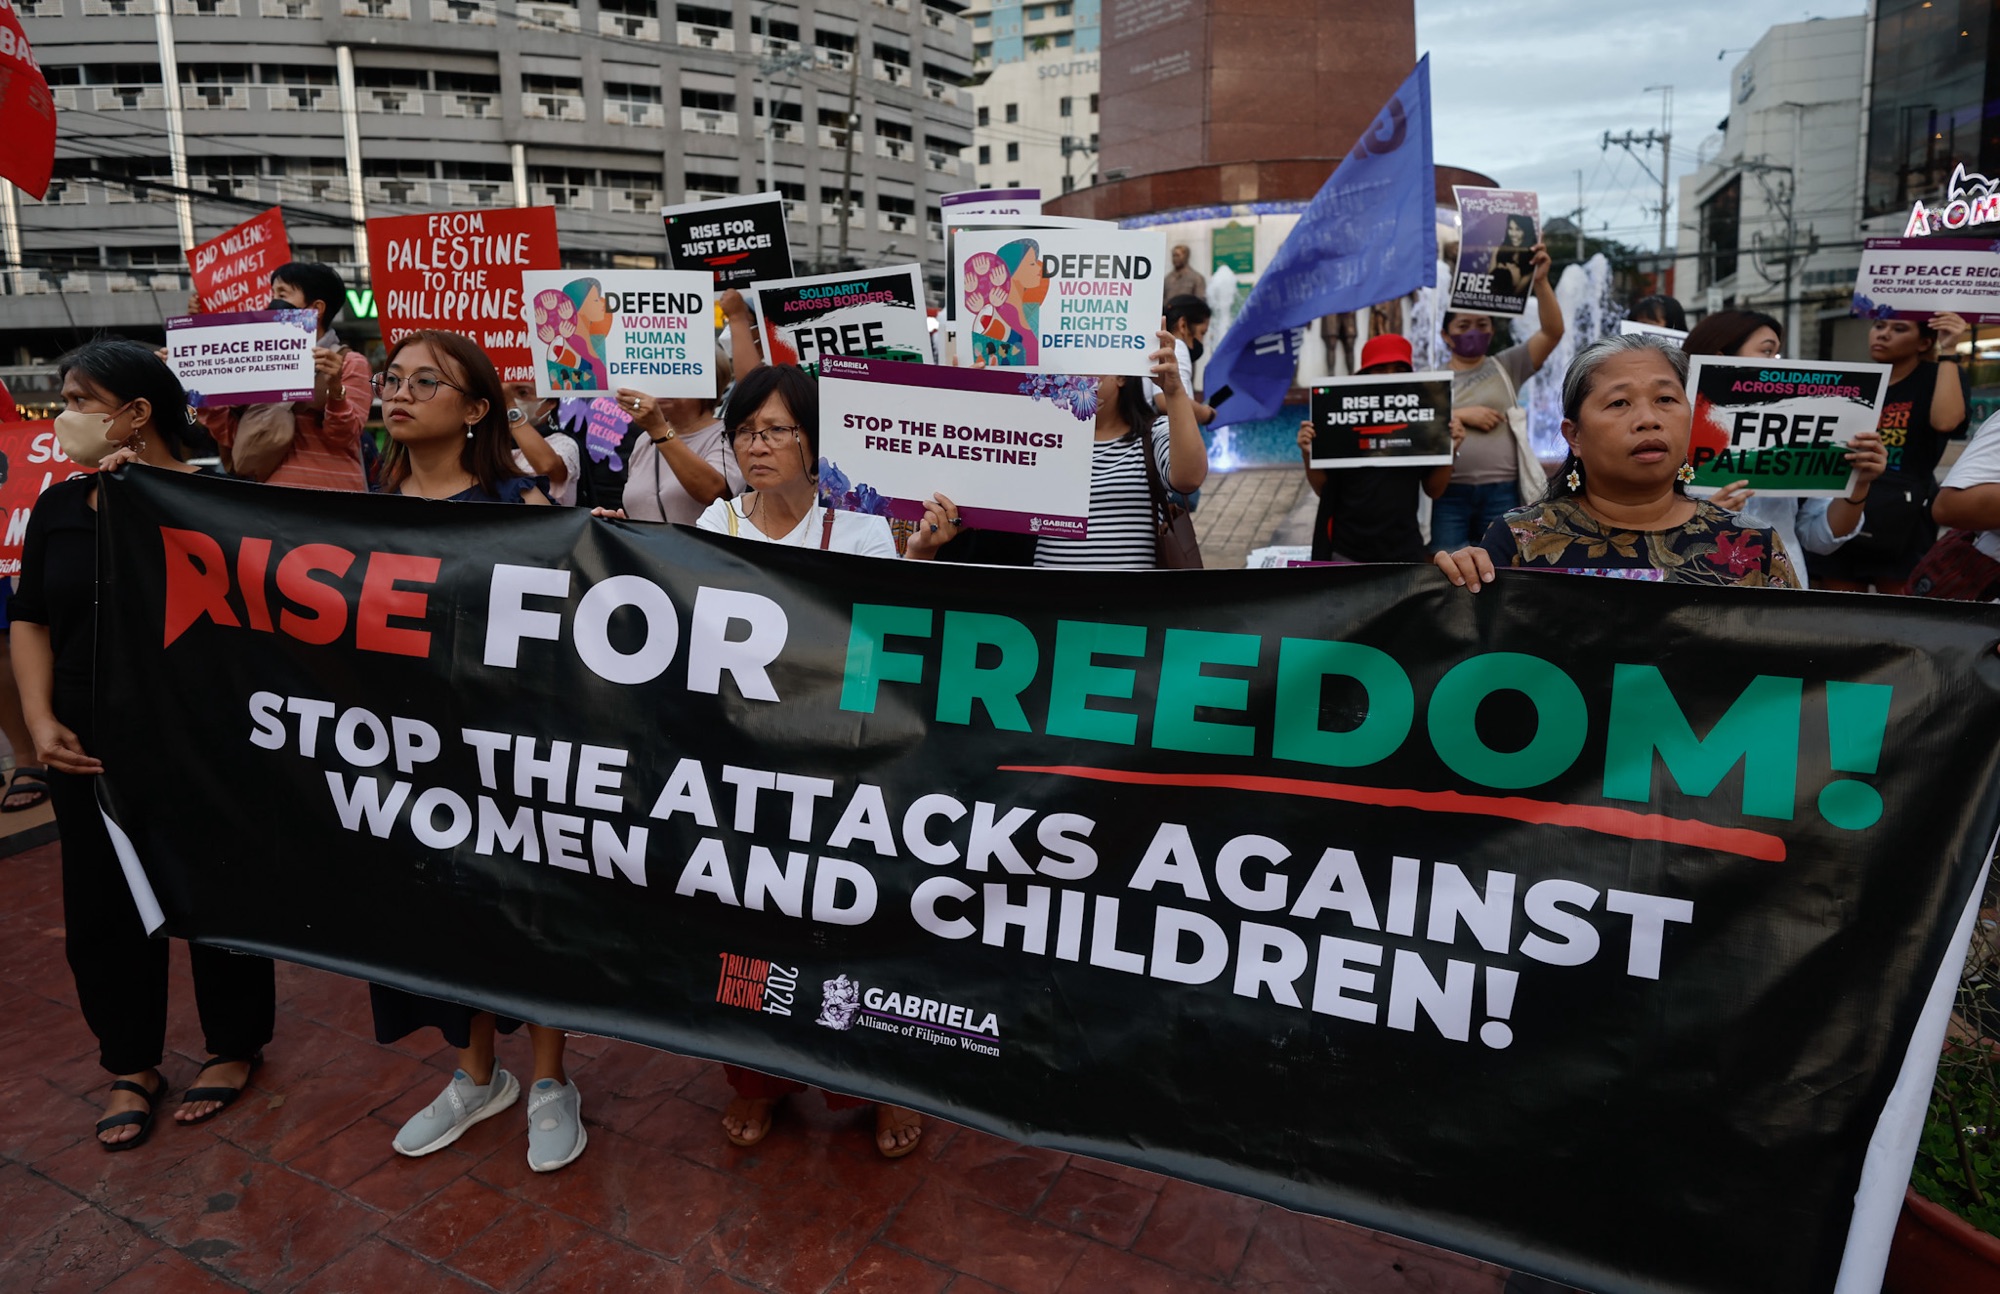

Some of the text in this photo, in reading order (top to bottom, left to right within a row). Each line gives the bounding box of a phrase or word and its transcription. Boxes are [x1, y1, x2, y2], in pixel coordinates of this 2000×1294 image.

[1037, 60, 1098, 80] SOUTH
[428, 212, 484, 237] FROM
[689, 220, 755, 239] RISE FOR
[195, 219, 272, 273] END VIOLENCE
[387, 232, 530, 272] PALESTINE
[681, 234, 772, 257] JUST PEACE!
[212, 249, 265, 287] AGAINST
[1042, 254, 1152, 280] DEFEND
[1869, 265, 2000, 278] LET PEACE REIG
[422, 270, 487, 291] TO THE
[799, 282, 869, 300] SOLIDARITY
[1059, 281, 1133, 297] WOMEN
[1457, 272, 1495, 294] FREE
[1872, 287, 1938, 295] OCCUPATION
[203, 280, 249, 312] WOMEN
[604, 292, 703, 314] DEFEND
[784, 290, 894, 312] ACROSS BORDERS
[1061, 299, 1129, 314] HUMAN
[622, 316, 688, 329] WOMEN
[1060, 316, 1127, 331] RIGHTS
[173, 338, 307, 358] LET PEACE REIGN!
[625, 332, 686, 344] HUMAN
[794, 321, 887, 361] FREE
[1042, 334, 1146, 350] DEFENDERS
[178, 353, 300, 368] END THE US-BACKED ISRAELI
[626, 347, 686, 360] RIGHTS
[179, 363, 299, 378] OCCUPATION OF PALESTINE!
[610, 363, 703, 375] DEFENDERS
[833, 360, 869, 370] GABRIELA
[1759, 370, 1842, 385] SOLIDARITY
[1731, 380, 1860, 397] ACROSS BORDERS
[1342, 394, 1419, 410] RISE FOR
[593, 413, 617, 427] and
[1327, 408, 1435, 425] JUST PEACE!
[843, 413, 1063, 449] STOP THE BOMBINGS!
[1731, 412, 1839, 449] FREE
[865, 435, 1037, 466] FREE PALESTINE!
[1693, 447, 1851, 476] PALESTINE
[1042, 519, 1083, 529] GABRIELA
[159, 526, 1893, 830] RISE FOR FREEDOM!
[249, 691, 1694, 980] STOP THE ATTACKS AGAINST
[325, 771, 1519, 1049] WOMEN AND CHILDREN!
[727, 954, 769, 983] BILLION
[721, 976, 765, 1012] RISING
[762, 962, 799, 1016] 2024
[863, 988, 1000, 1036] GABRIELA
[856, 1014, 1000, 1057] Alliance of Filipino Women
